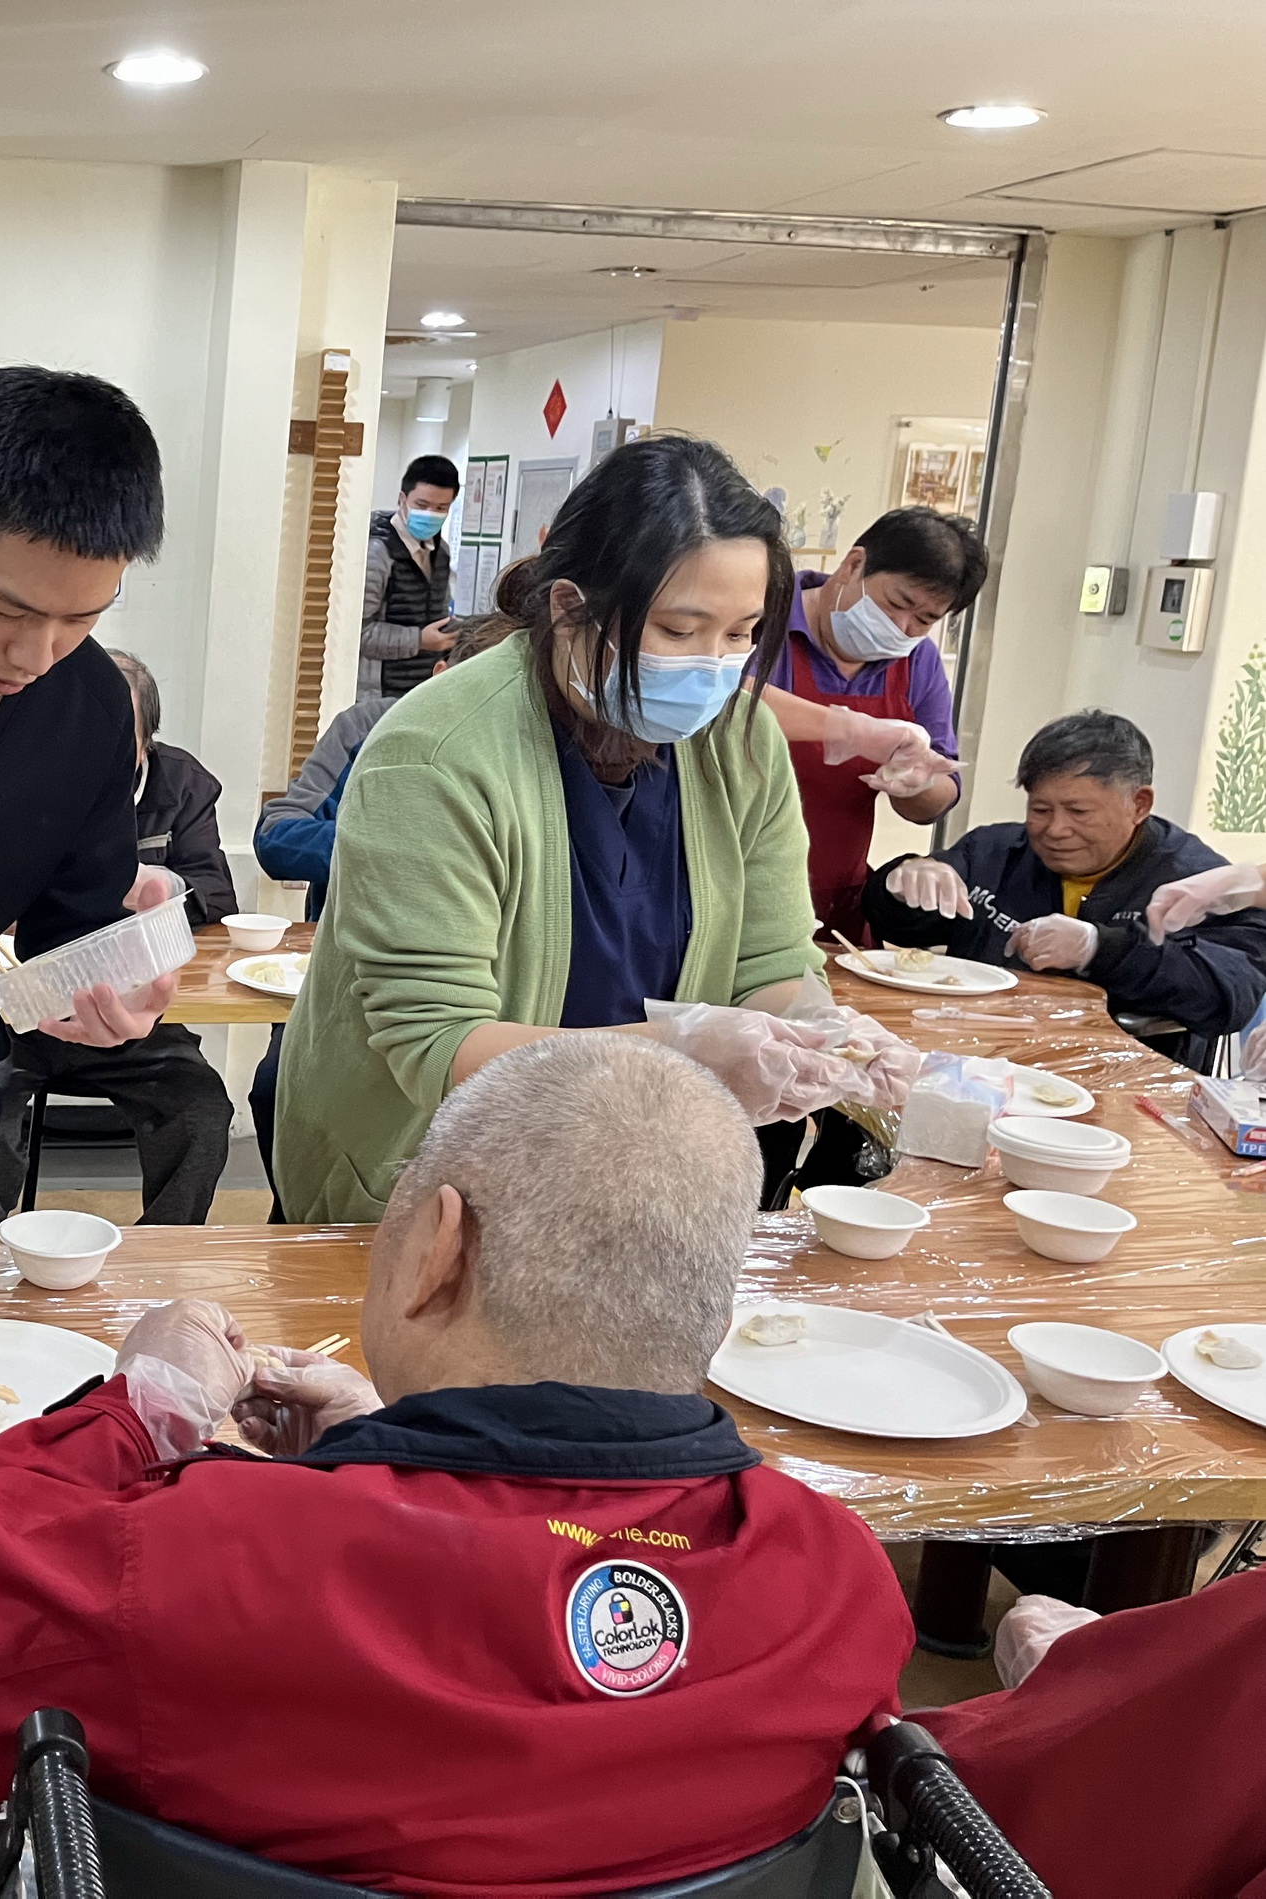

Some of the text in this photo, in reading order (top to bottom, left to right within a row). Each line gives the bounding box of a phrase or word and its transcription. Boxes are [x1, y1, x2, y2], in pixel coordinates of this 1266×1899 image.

[576, 1577, 604, 1660] FASTER DRYING
[614, 1571, 678, 1639] BOLDER BLACKS
[595, 1619, 663, 1647] ColorLok
[602, 1638, 659, 1657] TECHNOLOGY
